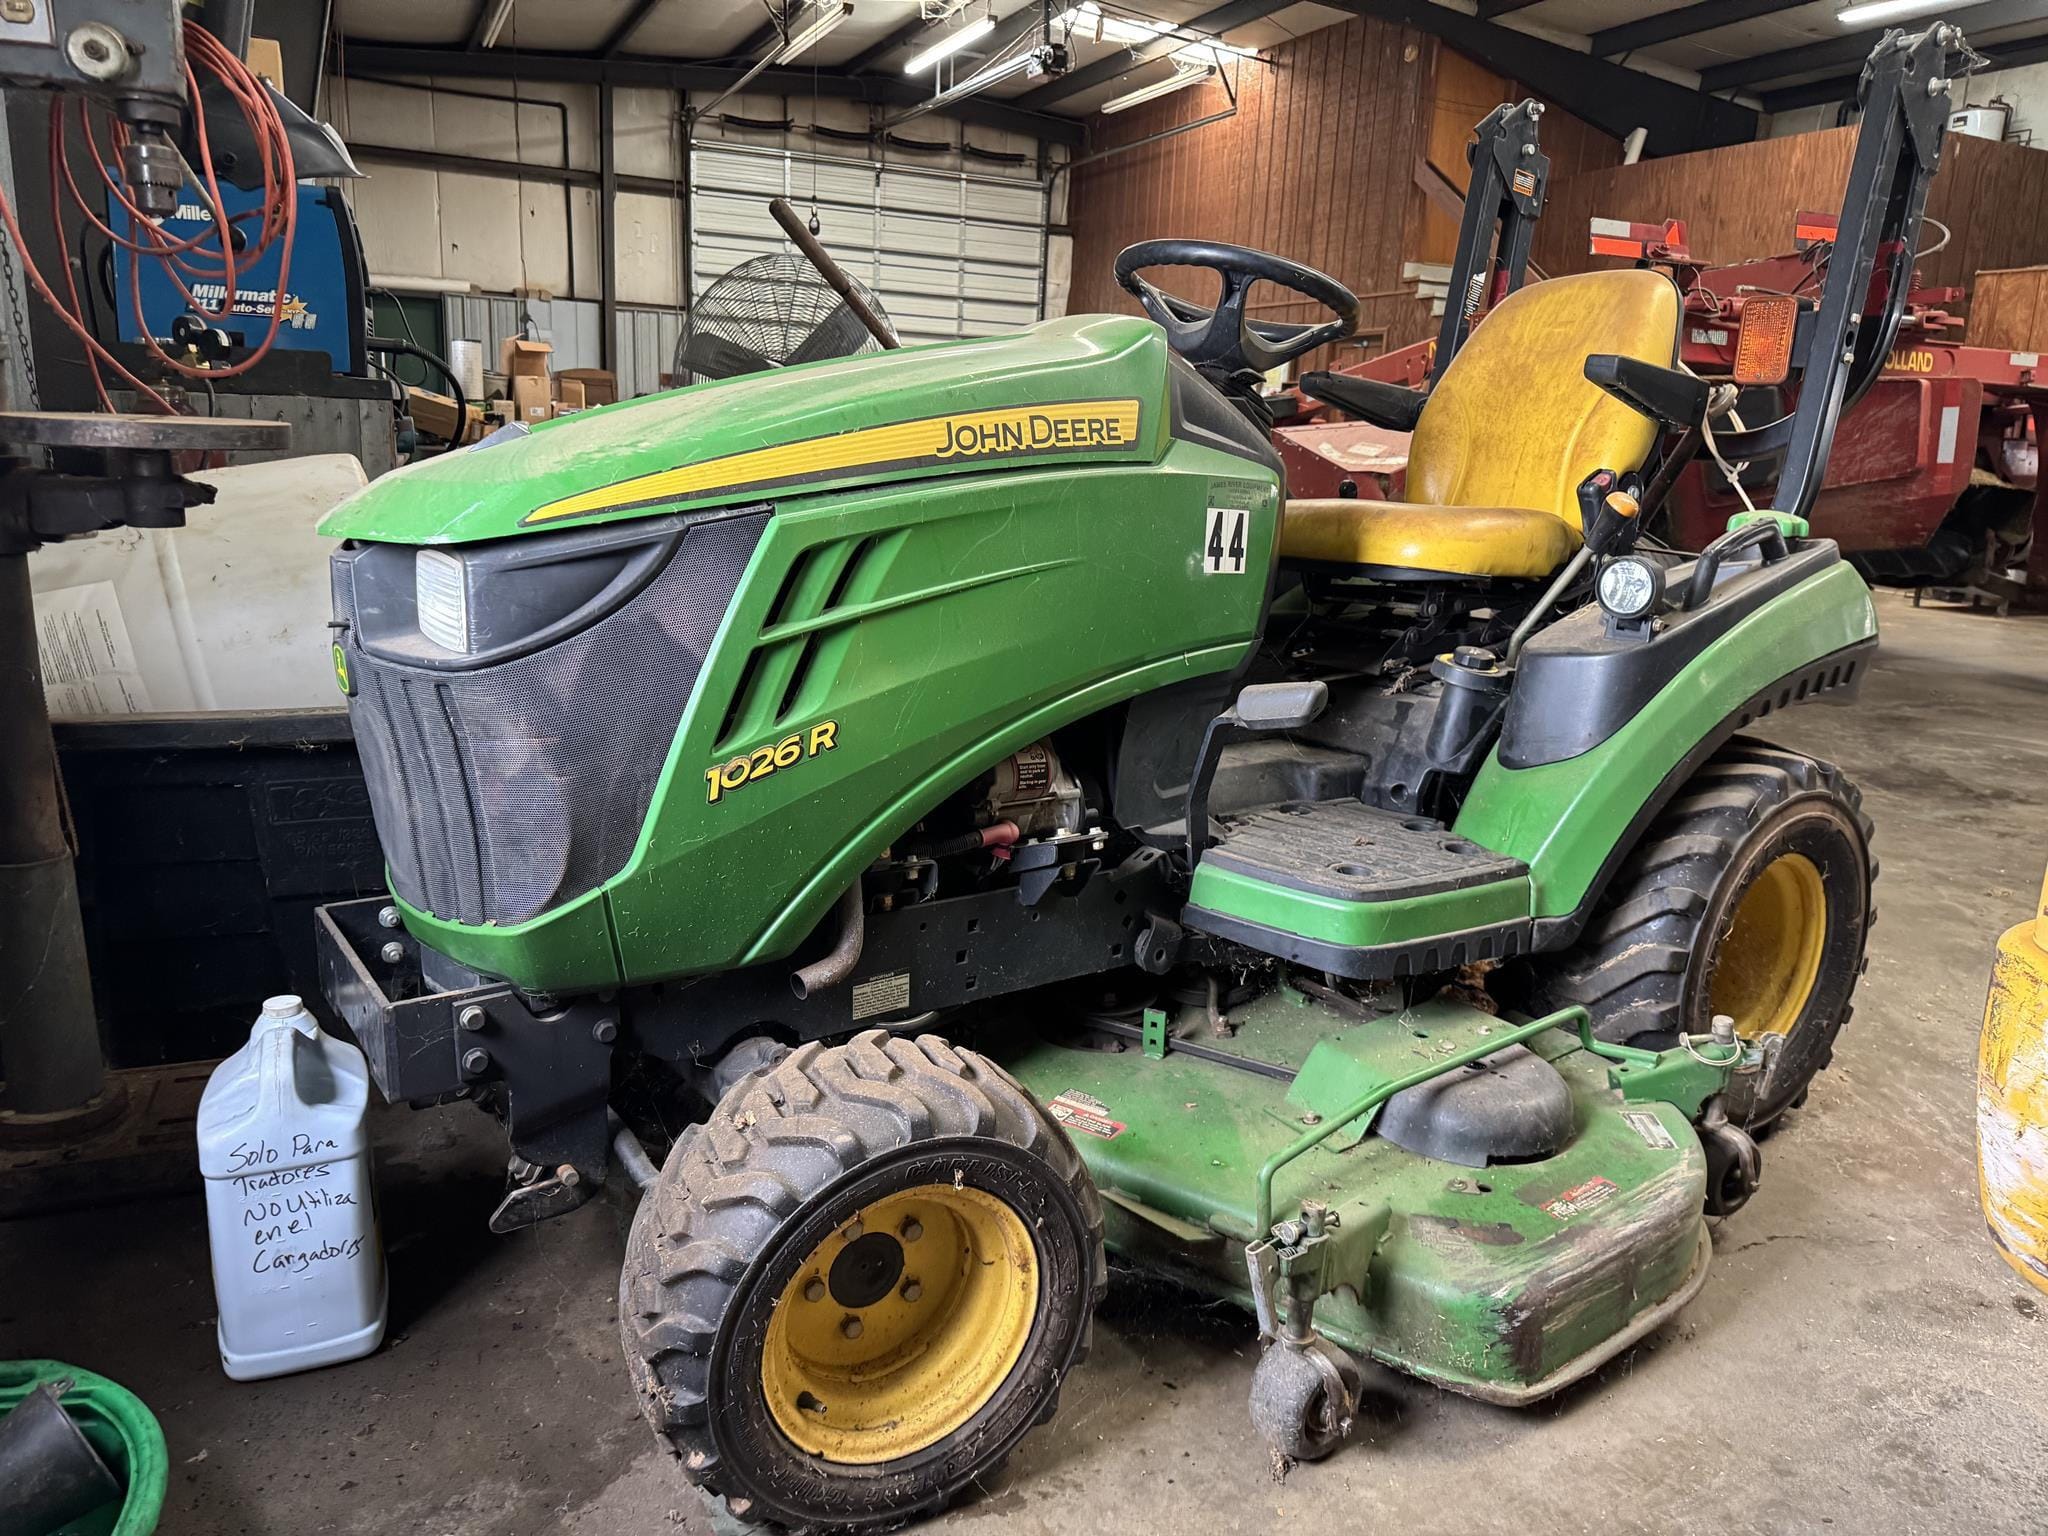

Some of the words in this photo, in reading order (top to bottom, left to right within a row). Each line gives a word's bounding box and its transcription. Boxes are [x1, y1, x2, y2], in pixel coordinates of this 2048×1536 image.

[170, 204, 215, 222] Mille
[192, 284, 291, 304] Millrmatc
[1884, 349, 1934, 373] OLLAND
[936, 421, 1023, 454] JOHN
[1029, 414, 1122, 445] DEERE
[1207, 511, 1245, 571] 44
[706, 735, 802, 802] 1026
[809, 721, 838, 757] R
[226, 1140, 279, 1173] Solo
[292, 1133, 339, 1157] Para
[244, 1203, 282, 1227] NO
[286, 1188, 358, 1214] Utiliza
[255, 1225, 282, 1245] en
[288, 1211, 313, 1234] el
